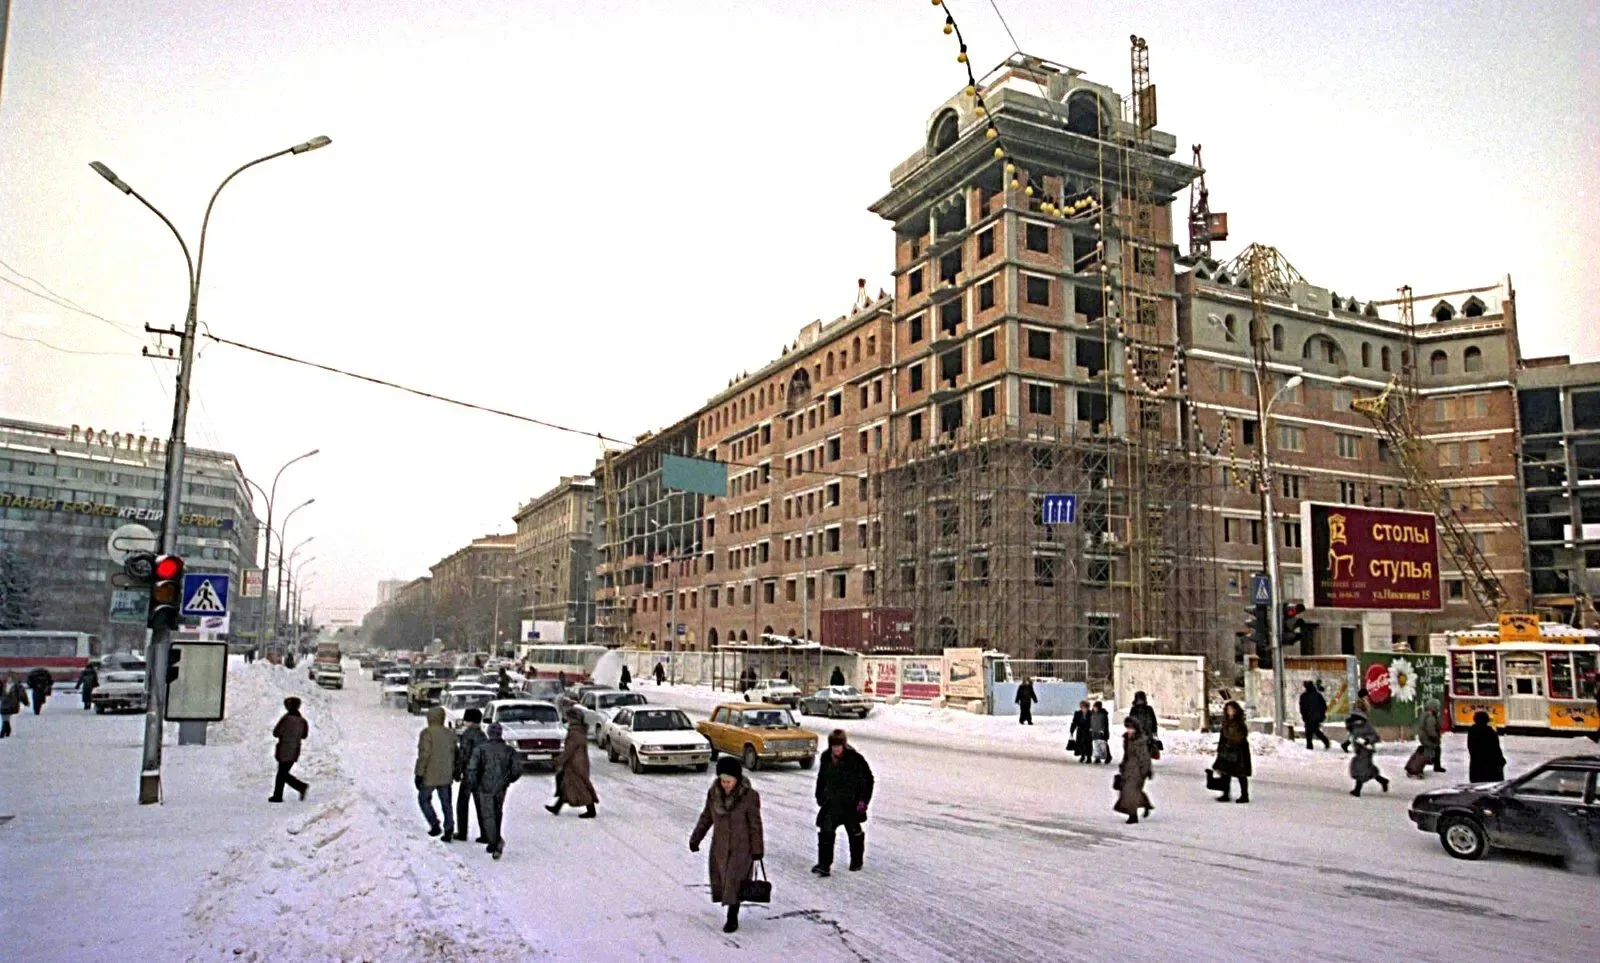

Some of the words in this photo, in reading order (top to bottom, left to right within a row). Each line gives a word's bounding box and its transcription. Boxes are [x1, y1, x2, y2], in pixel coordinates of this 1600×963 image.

[71, 423, 168, 454] РОССТРА
[1372, 523, 1430, 544] СТОЛЫ
[1369, 559, 1432, 584] СТУЛЬЯ
[1501, 616, 1537, 626] CAMEL
[1461, 703, 1499, 715] CAMEL
[1556, 707, 1597, 718] CAMEL
